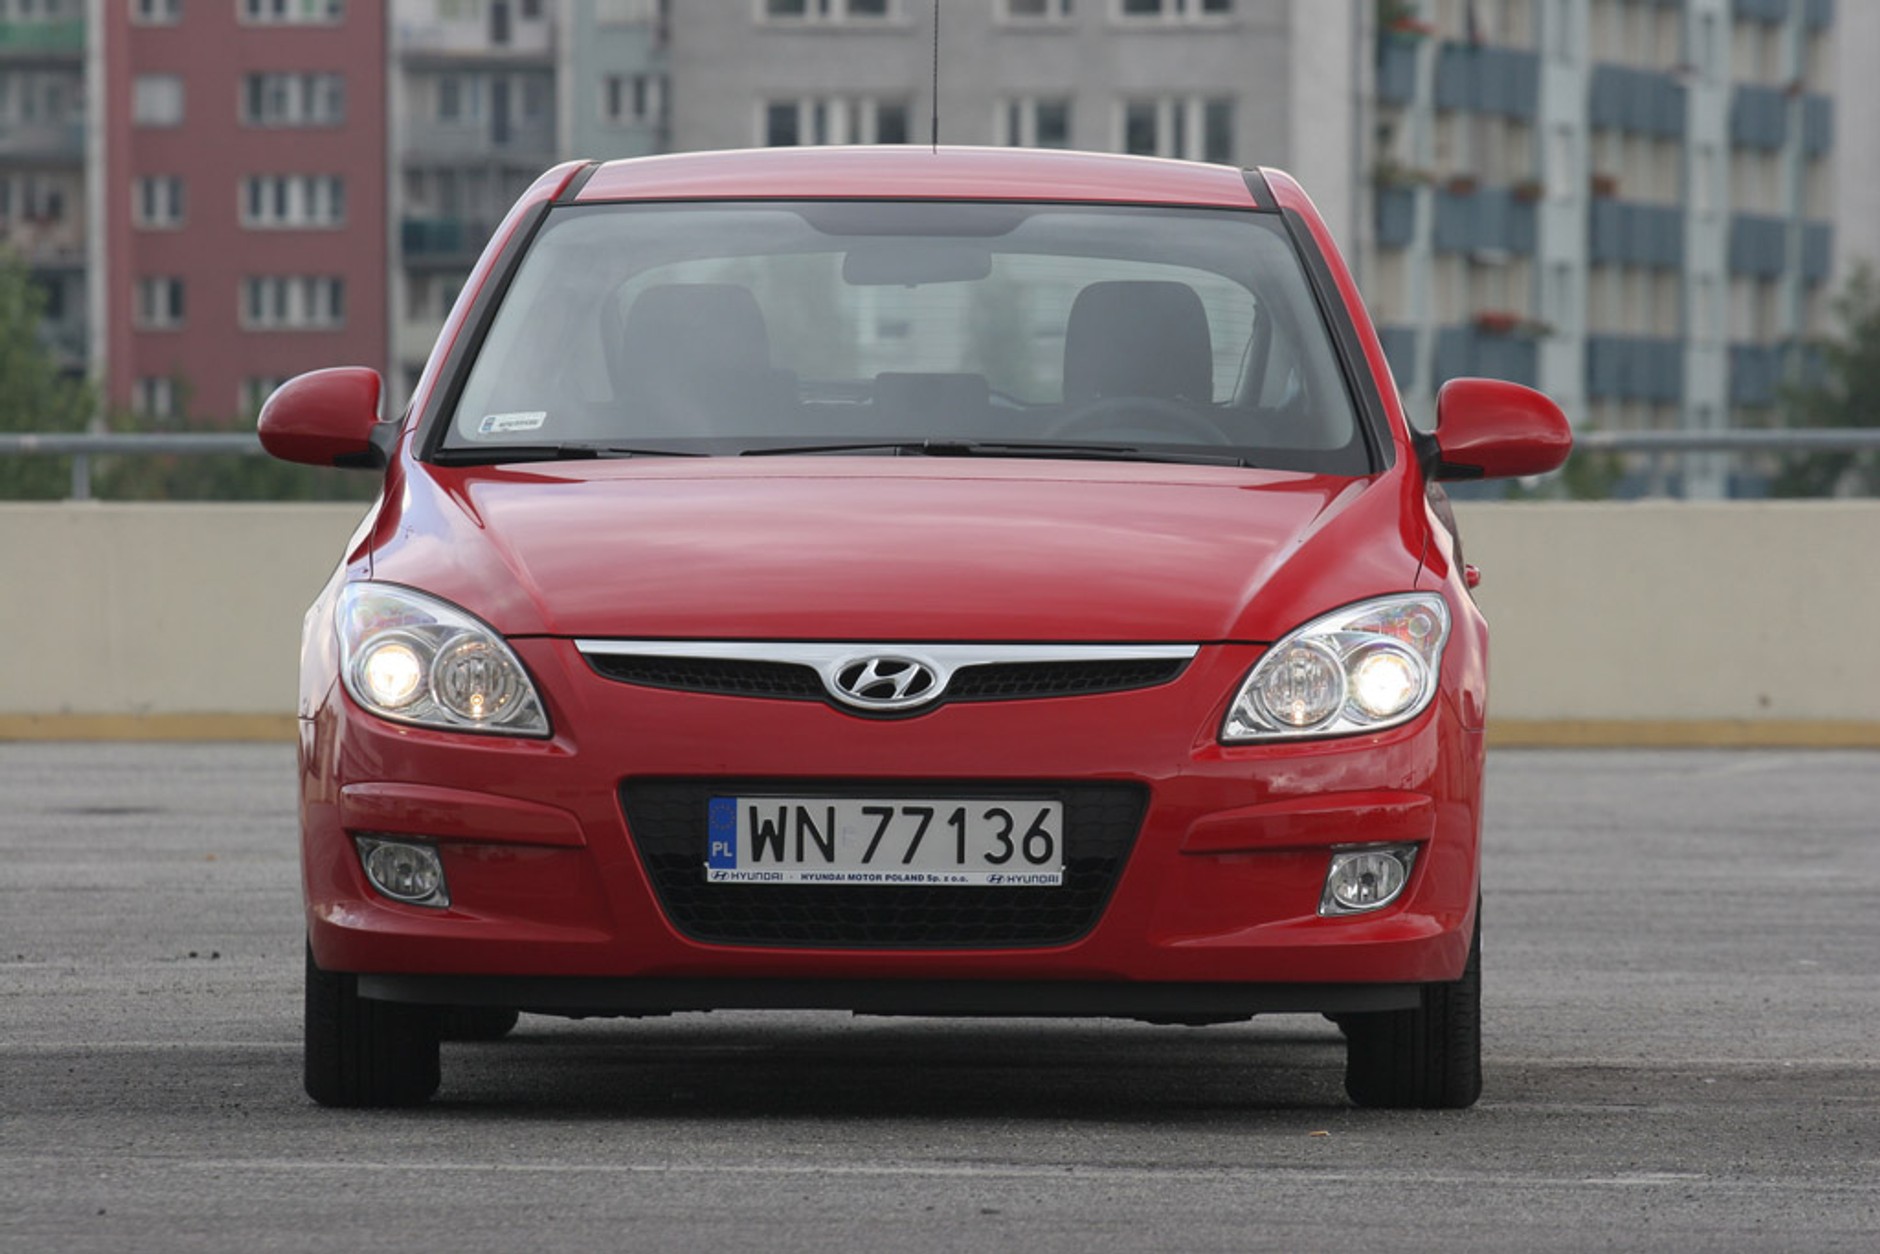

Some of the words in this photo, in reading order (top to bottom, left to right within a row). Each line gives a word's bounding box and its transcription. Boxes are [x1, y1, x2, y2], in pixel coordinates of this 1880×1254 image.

[749, 805, 835, 863] WN
[861, 806, 1054, 865] 77136
[712, 841, 733, 857] PL
[731, 872, 783, 881] HYUNDAI
[801, 873, 846, 881] HYUNDAI
[847, 873, 883, 882] MOTOR
[885, 874, 924, 882] POLAND
[927, 874, 941, 883] Sp.
[1007, 875, 1059, 884] HYUNDAI
